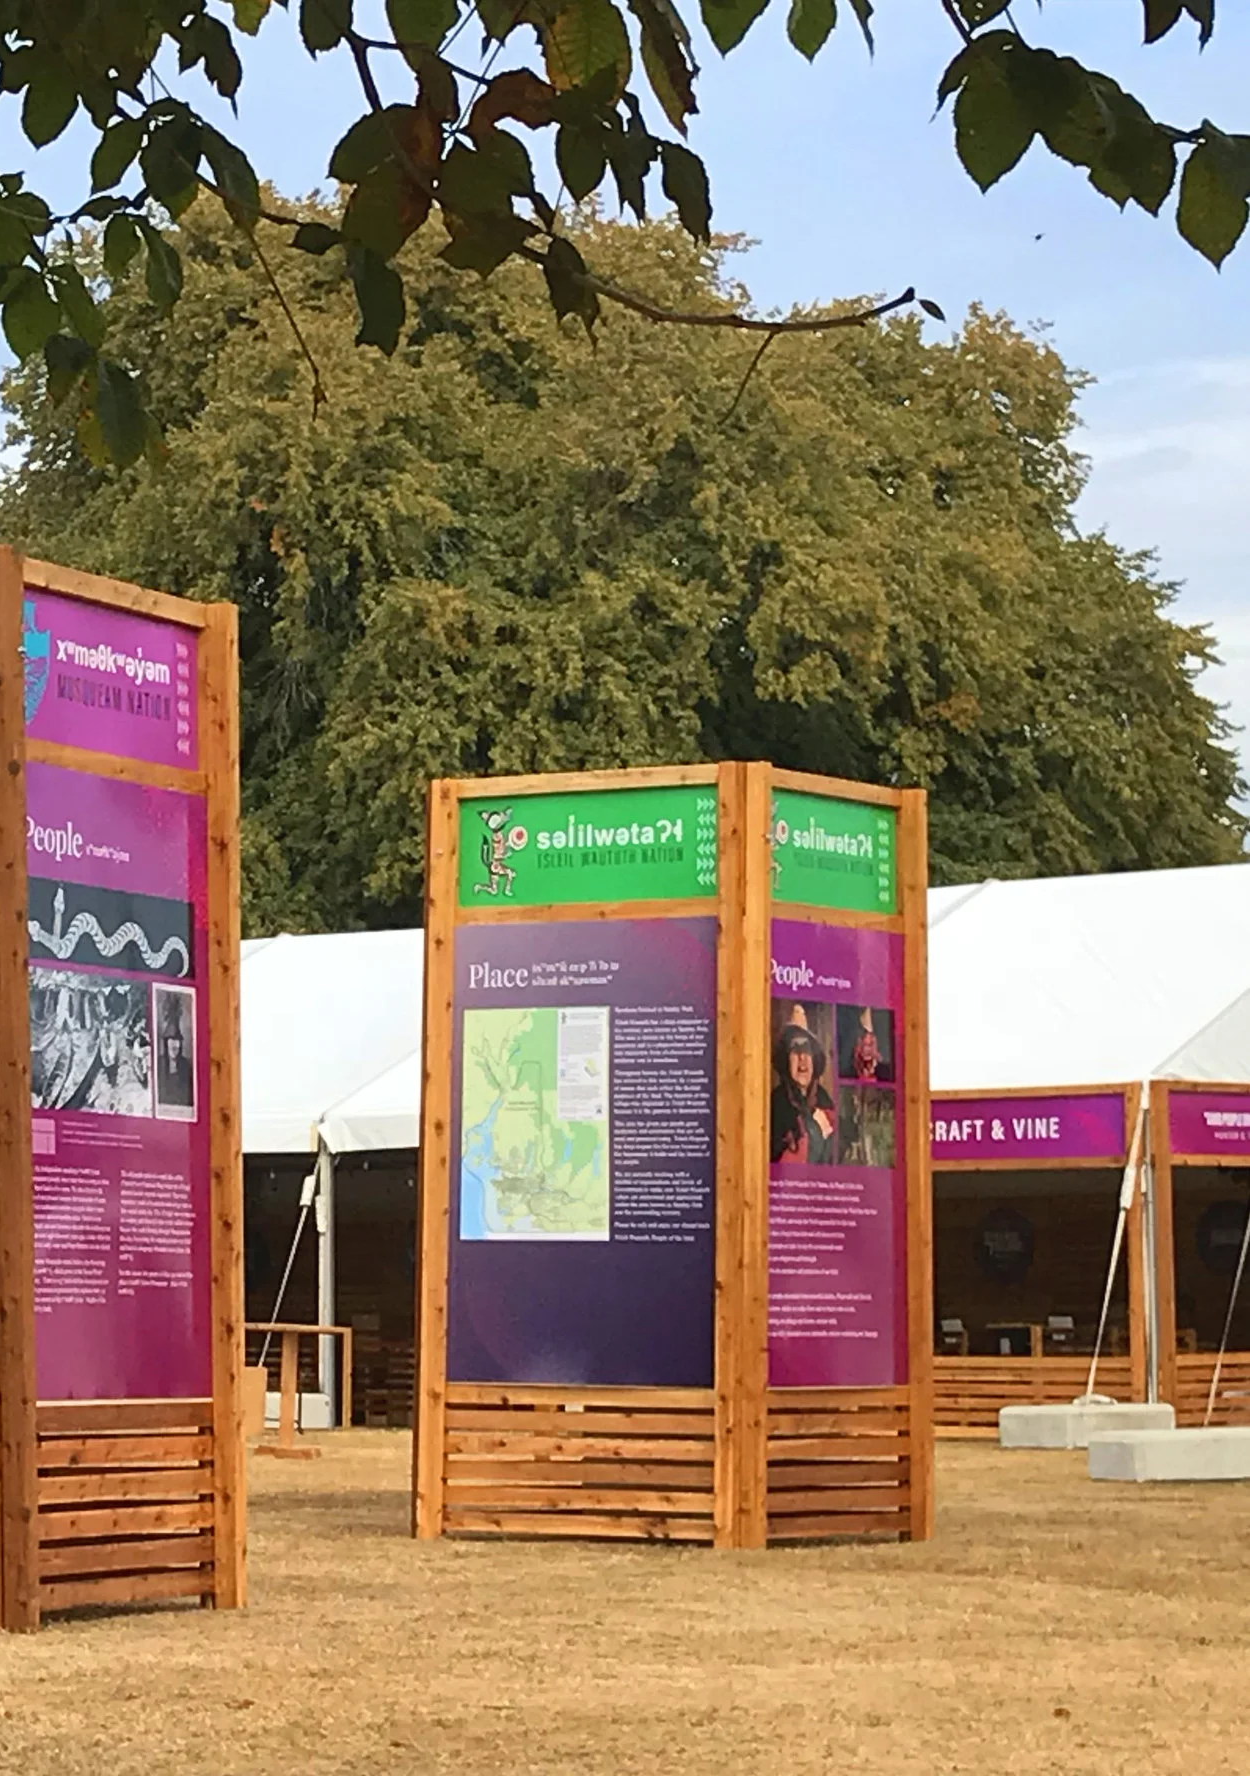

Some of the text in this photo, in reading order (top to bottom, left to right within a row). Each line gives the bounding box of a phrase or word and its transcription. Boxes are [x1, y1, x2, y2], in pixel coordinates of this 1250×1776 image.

[469, 961, 529, 989] Place
[929, 1116, 1061, 1142] RAFT & VINE
